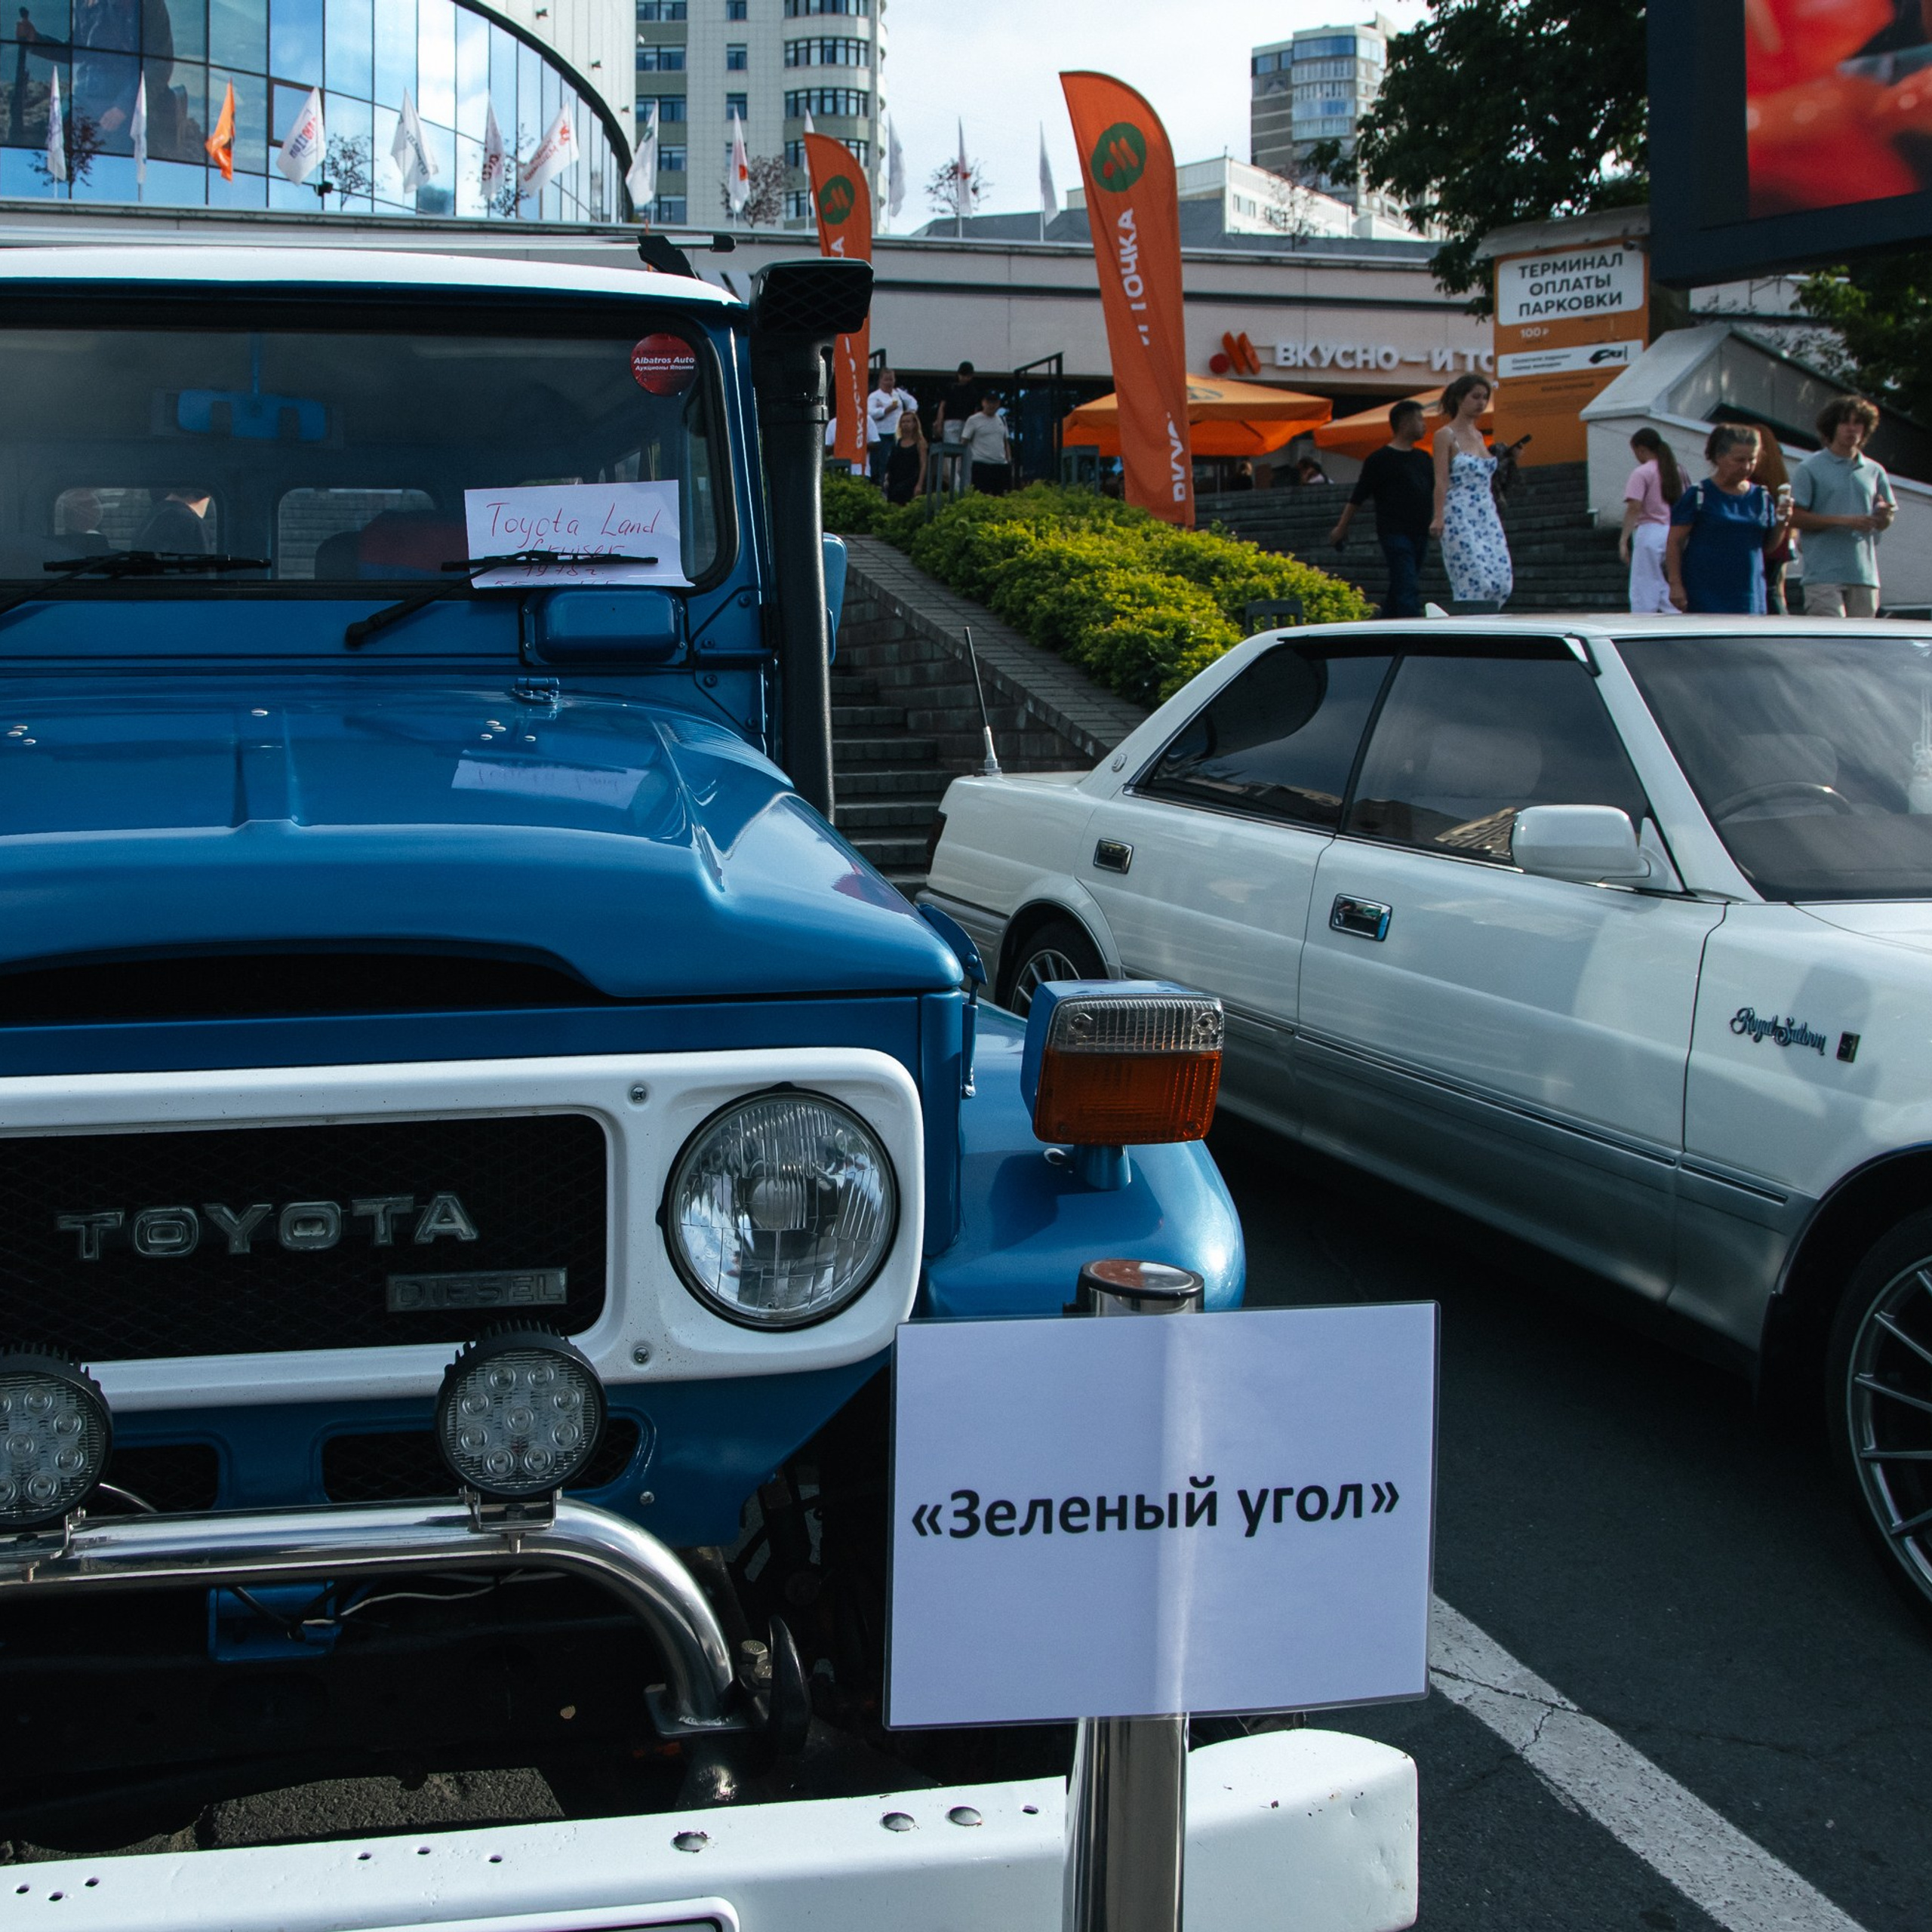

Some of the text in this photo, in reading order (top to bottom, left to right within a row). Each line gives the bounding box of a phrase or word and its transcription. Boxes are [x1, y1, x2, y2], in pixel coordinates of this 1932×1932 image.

[1518, 253, 1623, 279] ТЕРМИНАЛ
[1529, 274, 1611, 296] ОПЛАТЫ
[1518, 291, 1623, 317] ПАРКОВКИ
[1275, 342, 1400, 371] ВКУСНО
[1431, 348, 1455, 373] И
[486, 503, 661, 549] Toyota Land
[1729, 1007, 1826, 1056] Royal Saloon
[56, 1192, 478, 1260] TOYOTA
[395, 1274, 563, 1307] DIESEL
[911, 1475, 1401, 1539] «Зеленый угол»
